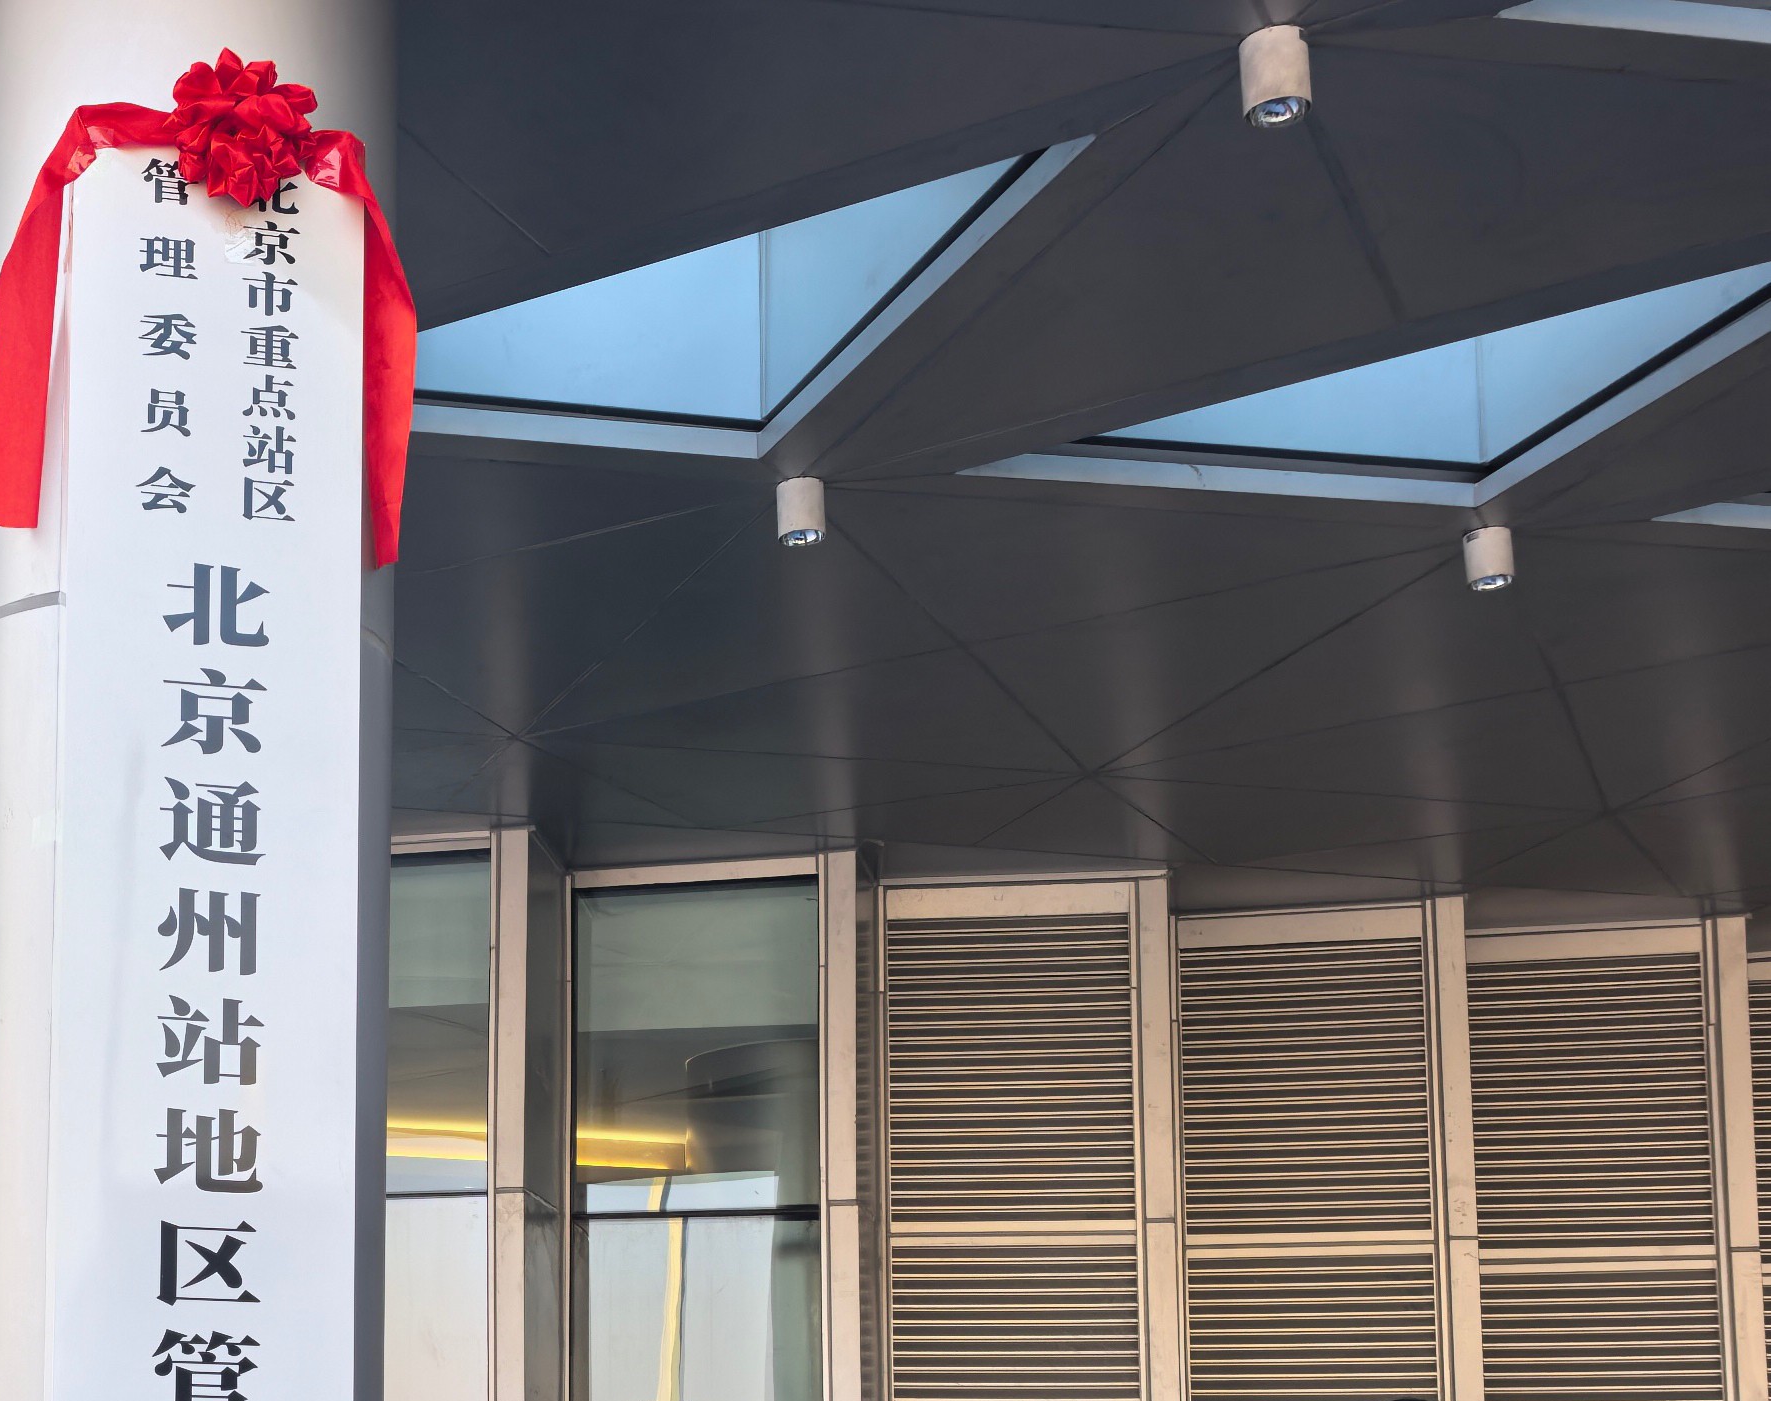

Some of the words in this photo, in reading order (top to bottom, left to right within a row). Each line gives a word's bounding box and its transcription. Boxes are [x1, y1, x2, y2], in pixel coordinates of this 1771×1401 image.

[136, 157, 199, 514] 管理委员会
